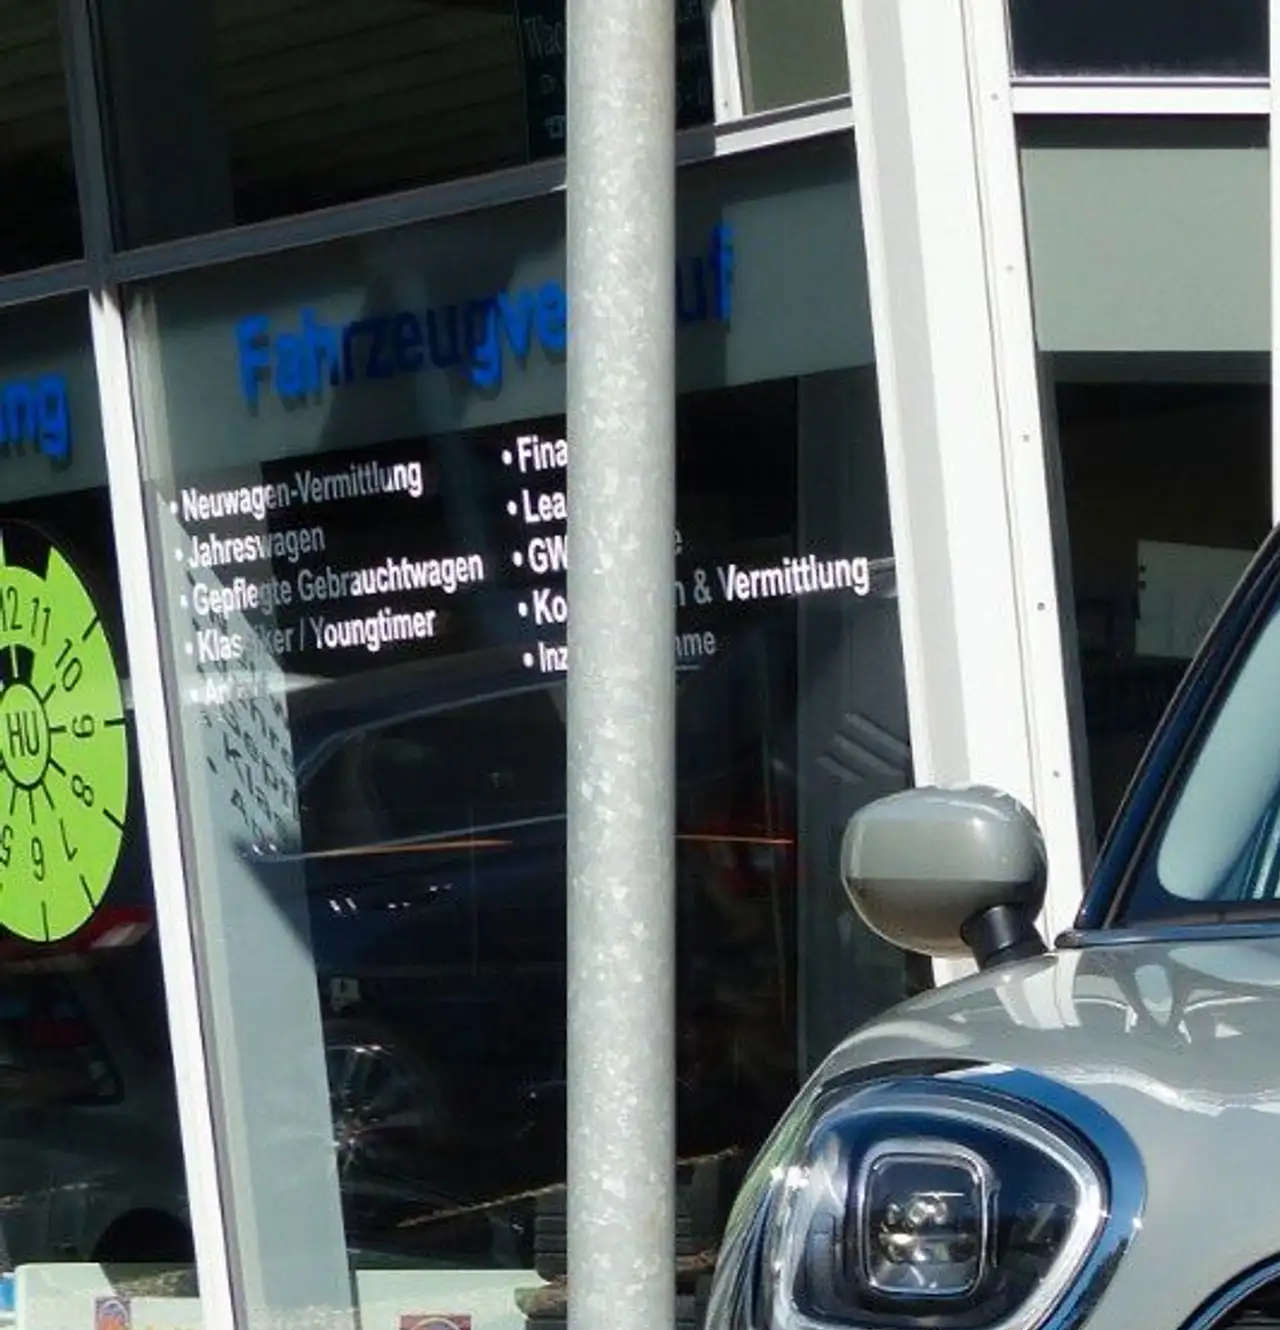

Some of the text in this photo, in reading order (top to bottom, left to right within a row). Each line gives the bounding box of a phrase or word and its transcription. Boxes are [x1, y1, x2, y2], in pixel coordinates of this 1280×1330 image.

[234, 223, 736, 407] Fahrzeugveuf
[516, 436, 567, 473] Fina
[181, 461, 423, 521] Neuwagen-Vermittlung
[522, 489, 567, 523] Lea
[189, 526, 326, 569] Jahreswagen
[192, 576, 292, 620] Gepflegte
[297, 553, 484, 602] Gebrauchtwagen
[717, 554, 869, 601] Vermittlung
[30, 597, 51, 647] 11
[309, 608, 436, 653] Youngtimer
[54, 638, 83, 692] 10
[6, 710, 39, 759] HU
[71, 774, 95, 808] 8
[59, 817, 79, 862] 7
